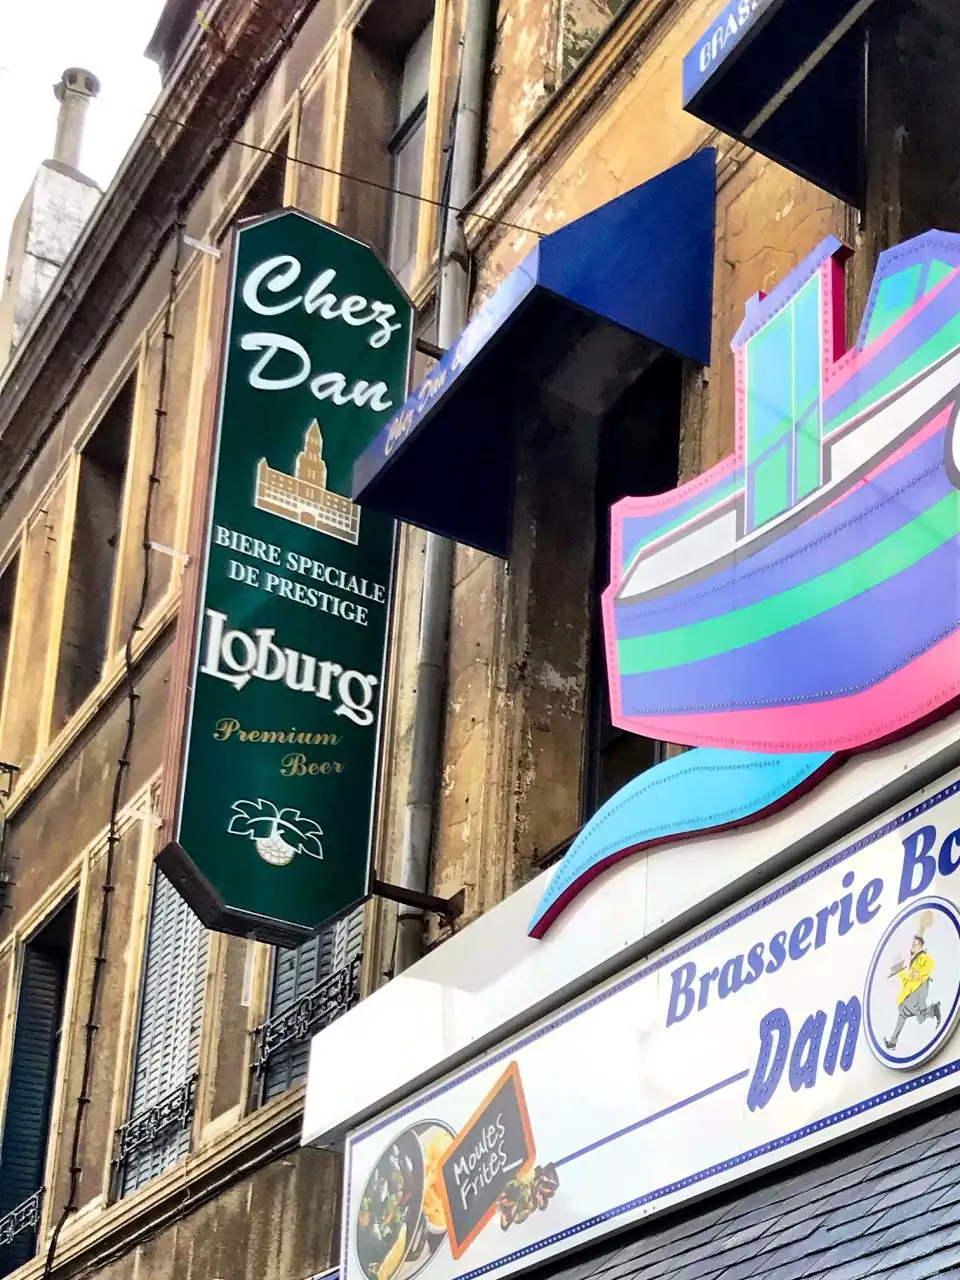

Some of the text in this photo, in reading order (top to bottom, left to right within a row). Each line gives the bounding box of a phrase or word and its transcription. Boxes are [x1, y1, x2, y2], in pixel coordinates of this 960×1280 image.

[700, 0, 759, 72] BRAS
[243, 255, 402, 349] Chez
[241, 332, 393, 412] Dan
[213, 524, 387, 604] BIERE SPECIALE
[228, 559, 369, 627] DE PRESTIGE
[200, 607, 379, 727] Loburg
[213, 717, 343, 746] Premium
[280, 752, 345, 777] Beer
[666, 871, 884, 1029] Brasserie
[746, 993, 862, 1113] Dan
[453, 1112, 505, 1186] Moules
[460, 1140, 507, 1211] Frites
